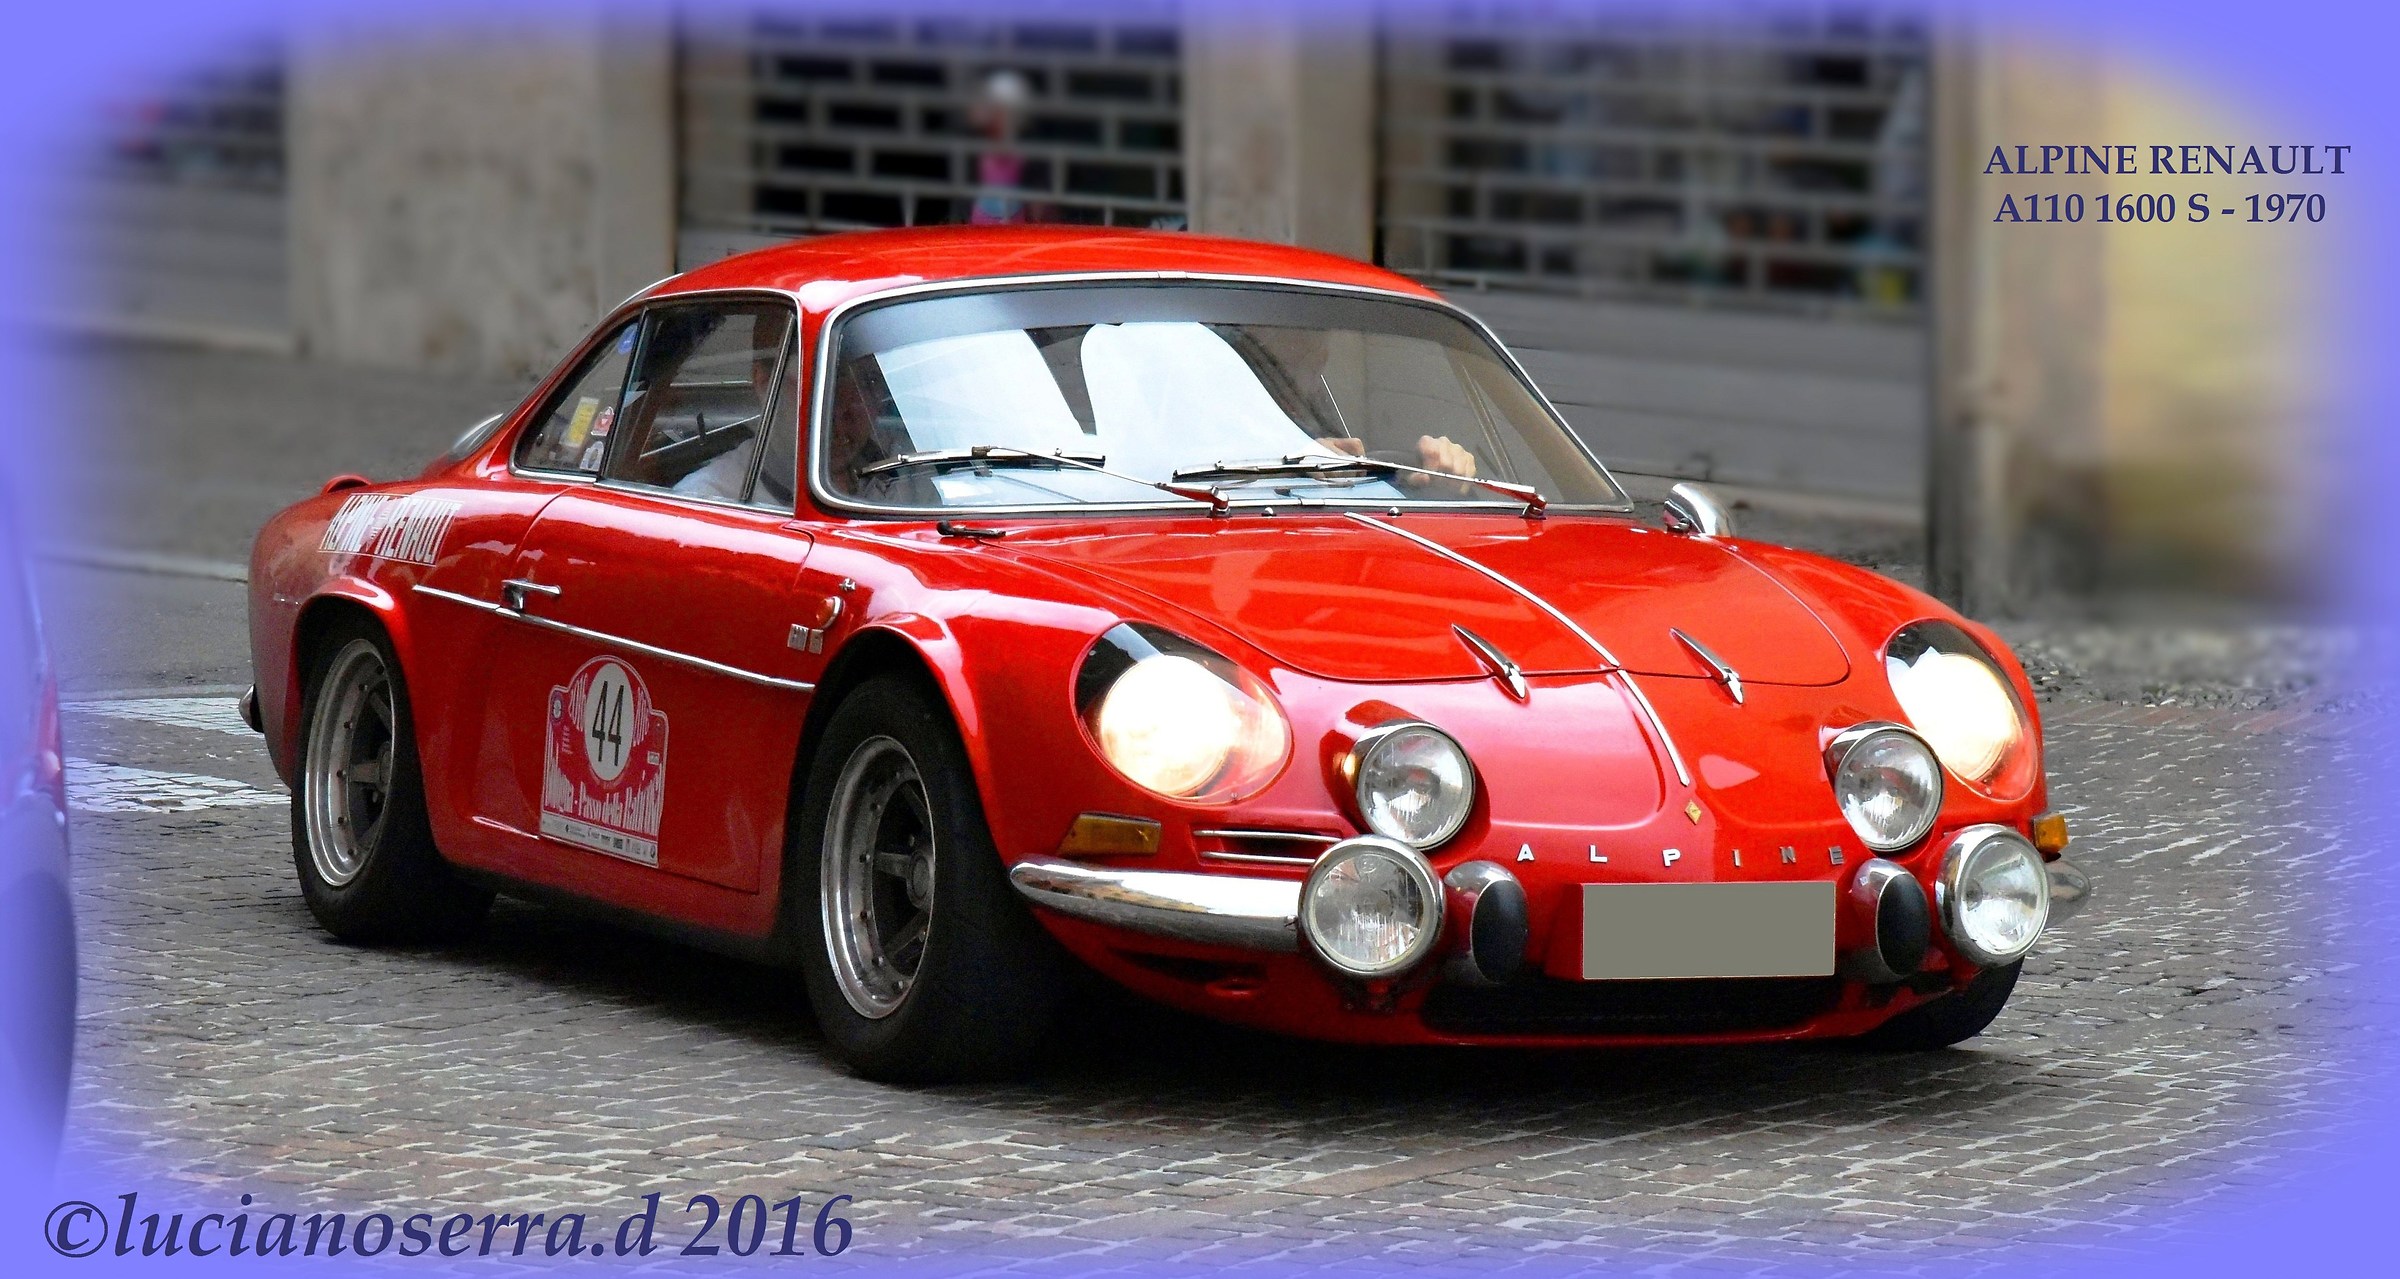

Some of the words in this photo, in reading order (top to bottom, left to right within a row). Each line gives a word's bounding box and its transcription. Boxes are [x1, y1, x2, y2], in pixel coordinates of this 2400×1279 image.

[373, 497, 464, 564] RENAULT
[591, 680, 625, 767] 44
[1516, 843, 1845, 868] ALPINE
